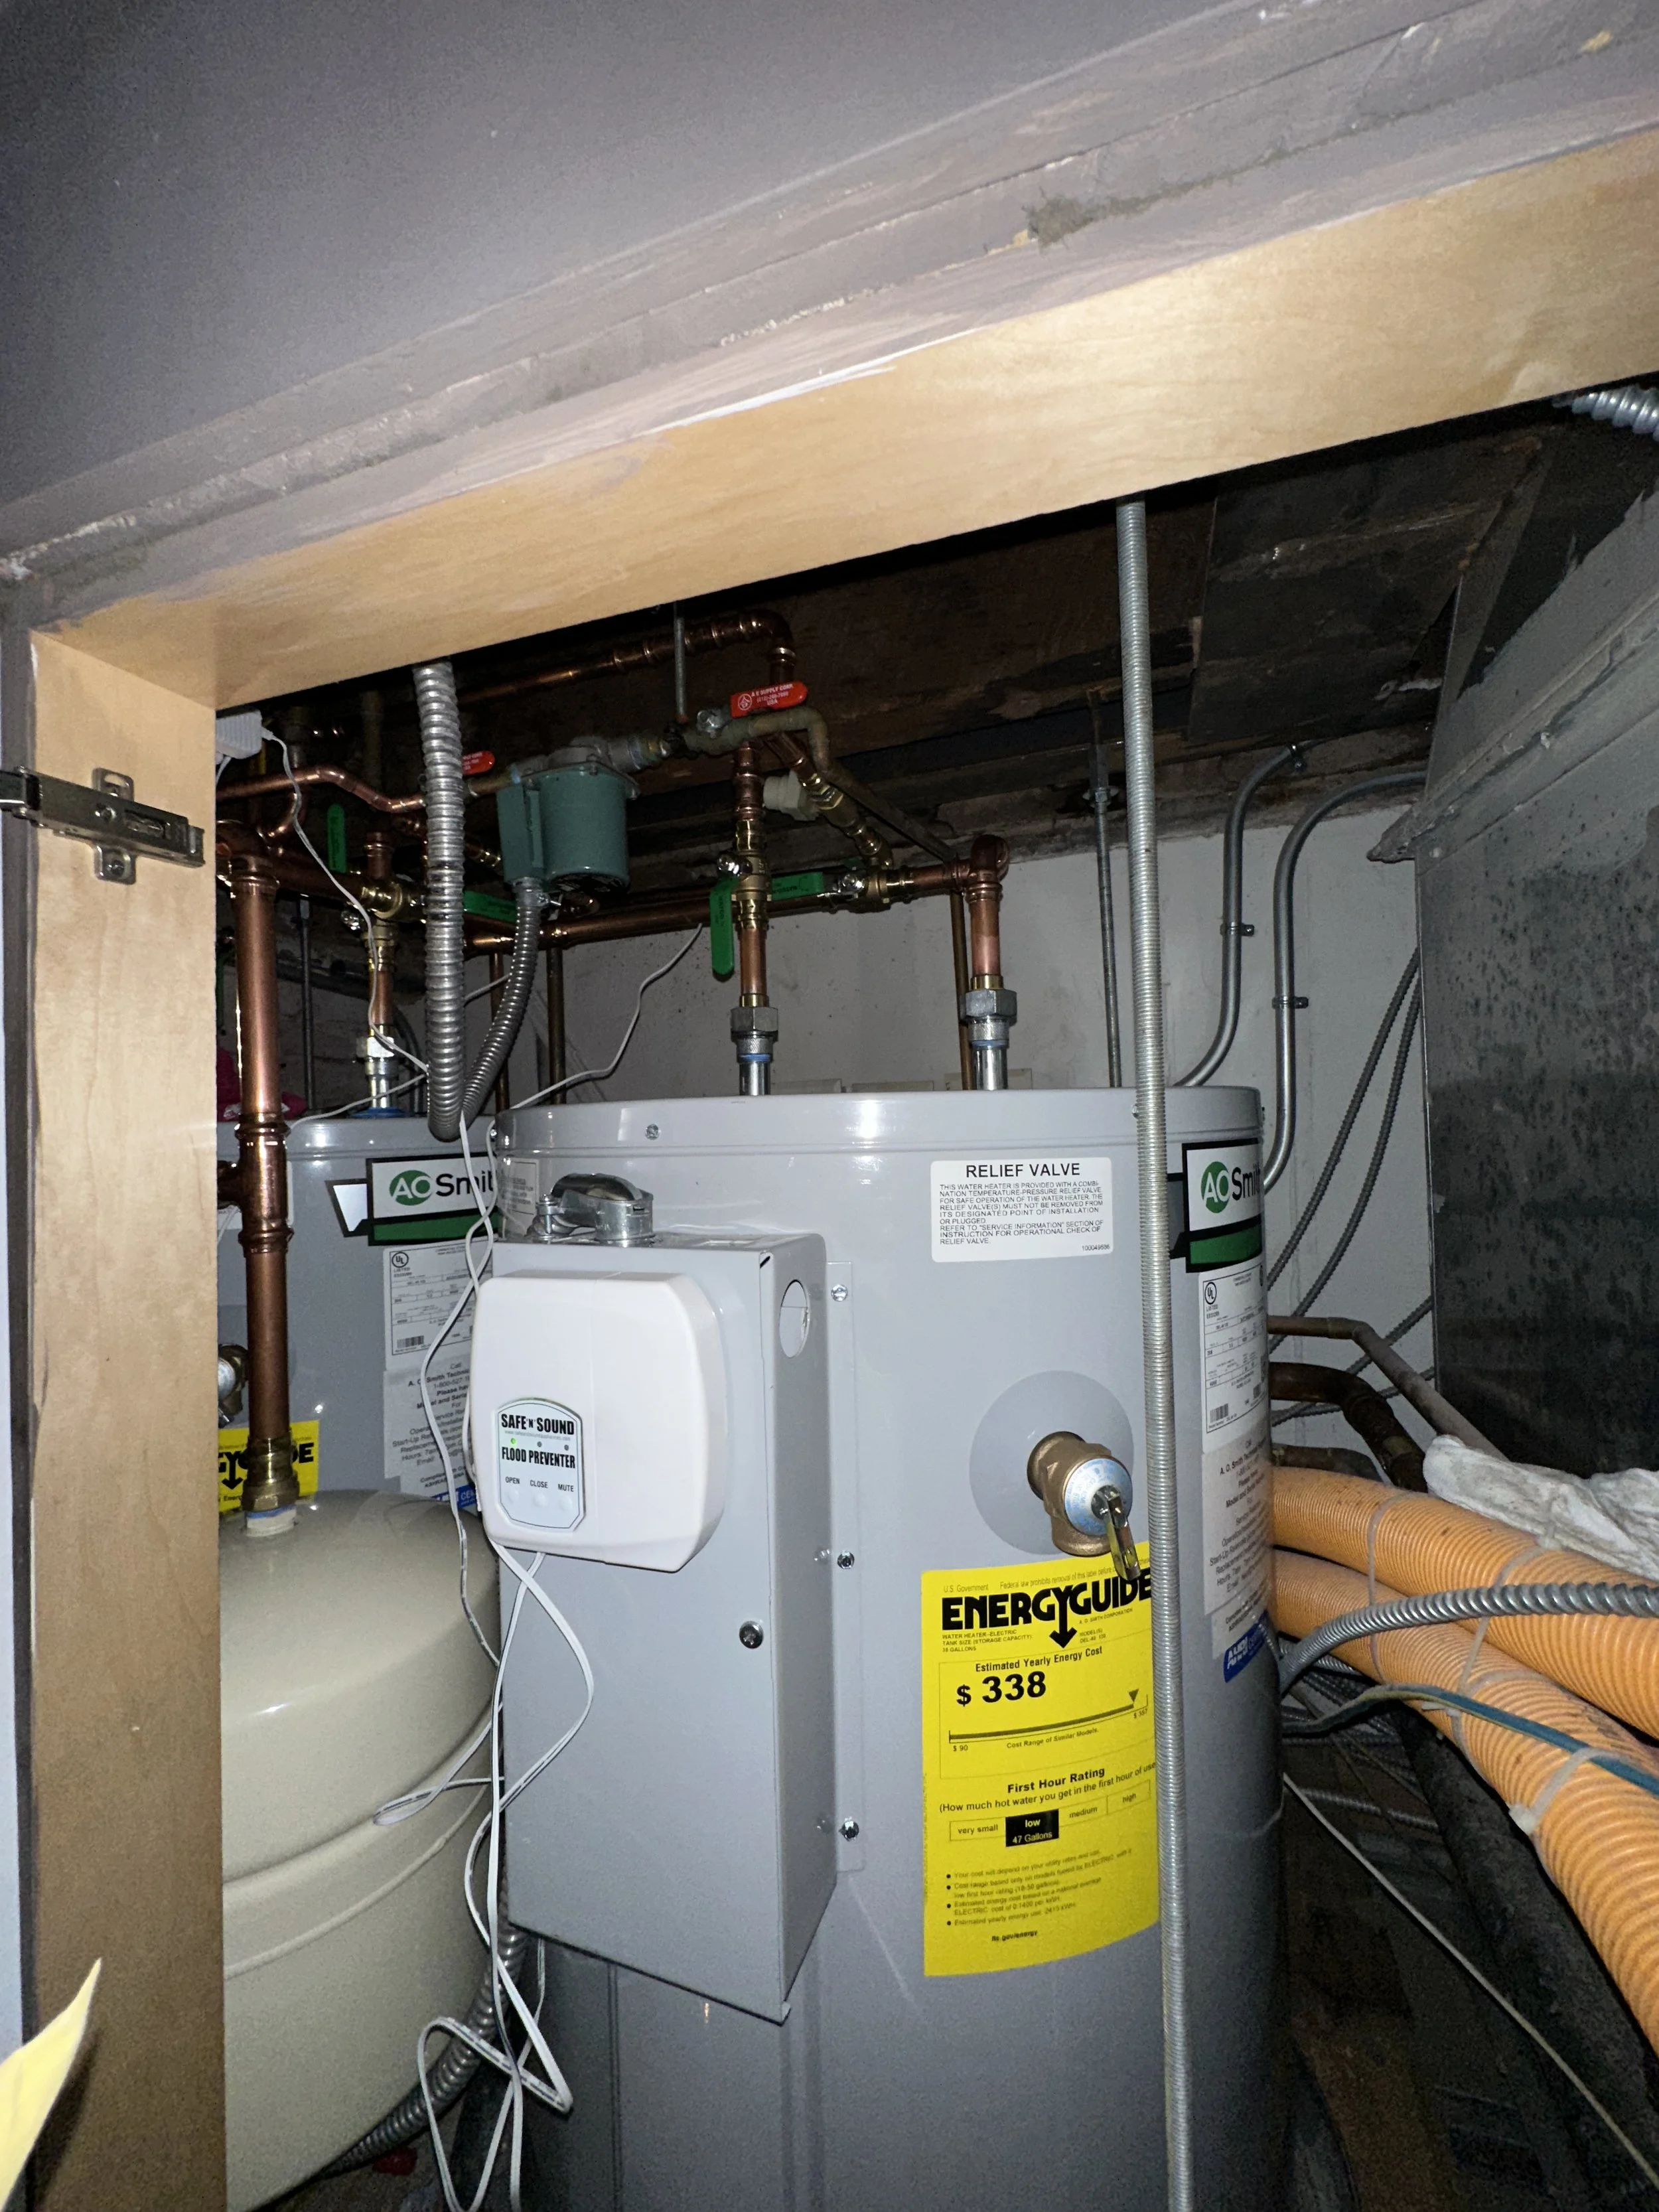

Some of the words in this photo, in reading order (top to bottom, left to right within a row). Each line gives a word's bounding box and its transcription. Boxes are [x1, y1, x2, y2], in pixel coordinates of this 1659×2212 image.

[966, 1164, 1023, 1178] RELIEF
[1029, 1163, 1080, 1177] VALVE
[435, 1170, 494, 1197] Smit
[969, 1188, 1058, 1197] TEMPERATURE-PRESSURE
[501, 1414, 527, 1430] SAFE
[536, 1418, 575, 1435] SOUND
[502, 1447, 526, 1463] FLOOD
[529, 1450, 575, 1469] PREVENTER
[506, 1476, 520, 1485] OPEN
[530, 1480, 548, 1489] CLOSE
[957, 1584, 989, 1592] Government
[1000, 1581, 1019, 1589] Federal
[1030, 1578, 1051, 1587] prohibits
[1052, 1574, 1071, 1584] removal
[942, 1567, 1151, 1631] ENERGYGUIDE
[1104, 1607, 1133, 1619] CORPORATION
[975, 1660, 1020, 1672] Estimated
[1023, 1657, 1051, 1668] Yearly
[1054, 1651, 1082, 1664] Energy
[1085, 1646, 1103, 1658] Cost
[957, 1684, 972, 1707] $
[982, 1671, 1046, 1703] 338
[1023, 1739, 1044, 1749] Range
[1054, 1733, 1075, 1741] Similar
[940, 1803, 964, 1813] (How
[966, 1800, 992, 1810] much
[1013, 1796, 1037, 1806] water
[1039, 1793, 1056, 1804] you
[1058, 1790, 1072, 1800] get
[1084, 1784, 1096, 1793] the
[1099, 1777, 1114, 1788] first
[1116, 1771, 1133, 1783] hour
[1135, 1765, 1142, 1776] of
[1007, 1781, 1035, 1793] First
[1039, 1777, 1066, 1789] Hour
[1070, 1768, 1105, 1783] Rating
[977, 1824, 998, 1832] small
[1025, 1819, 1041, 1828] low
[1070, 1806, 1098, 1818] medium
[1122, 1793, 1136, 1803] high
[1025, 1832, 1052, 1842] Gallons
